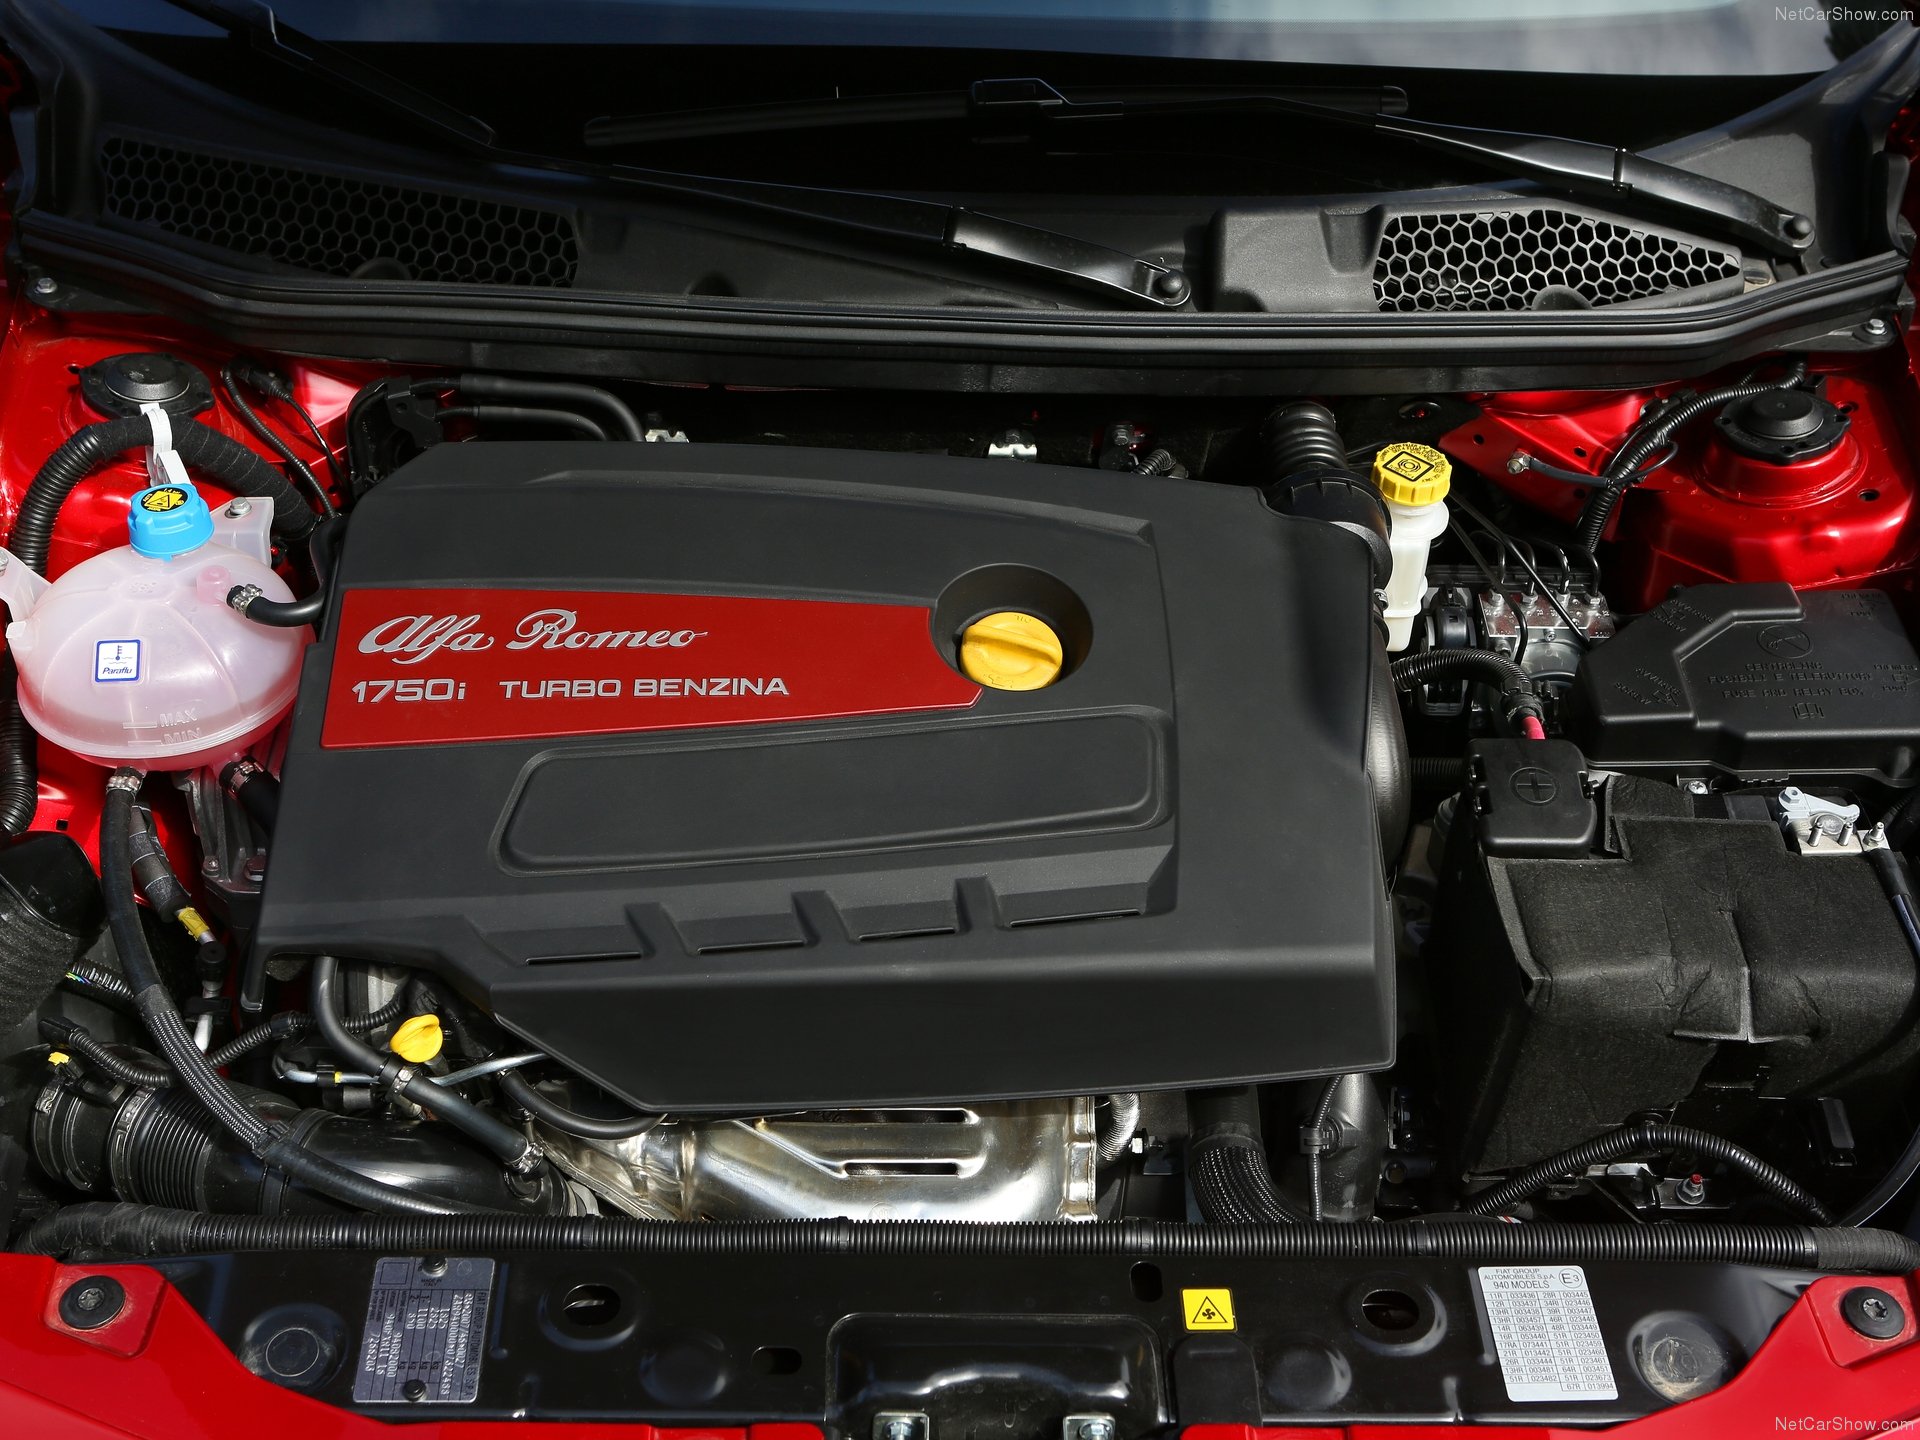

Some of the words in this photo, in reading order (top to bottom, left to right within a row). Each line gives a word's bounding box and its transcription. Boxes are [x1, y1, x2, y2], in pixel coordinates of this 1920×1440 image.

[357, 613, 494, 664] Alfa
[506, 608, 708, 651] Romeo
[102, 666, 133, 675] Paraflu
[352, 678, 466, 704] 1750i
[499, 679, 621, 699] TURBO
[633, 676, 790, 698] BENZINA
[1723, 690, 1756, 698] FUSE
[1762, 690, 1788, 698] AND
[1794, 688, 1834, 696] RELAY
[1840, 688, 1864, 696] BOX
[159, 708, 198, 727] MAX
[161, 728, 200, 745] MIN
[1511, 1281, 1550, 1289] MODELS
[477, 1292, 486, 1305] FIAT
[475, 1307, 485, 1329] GROUP
